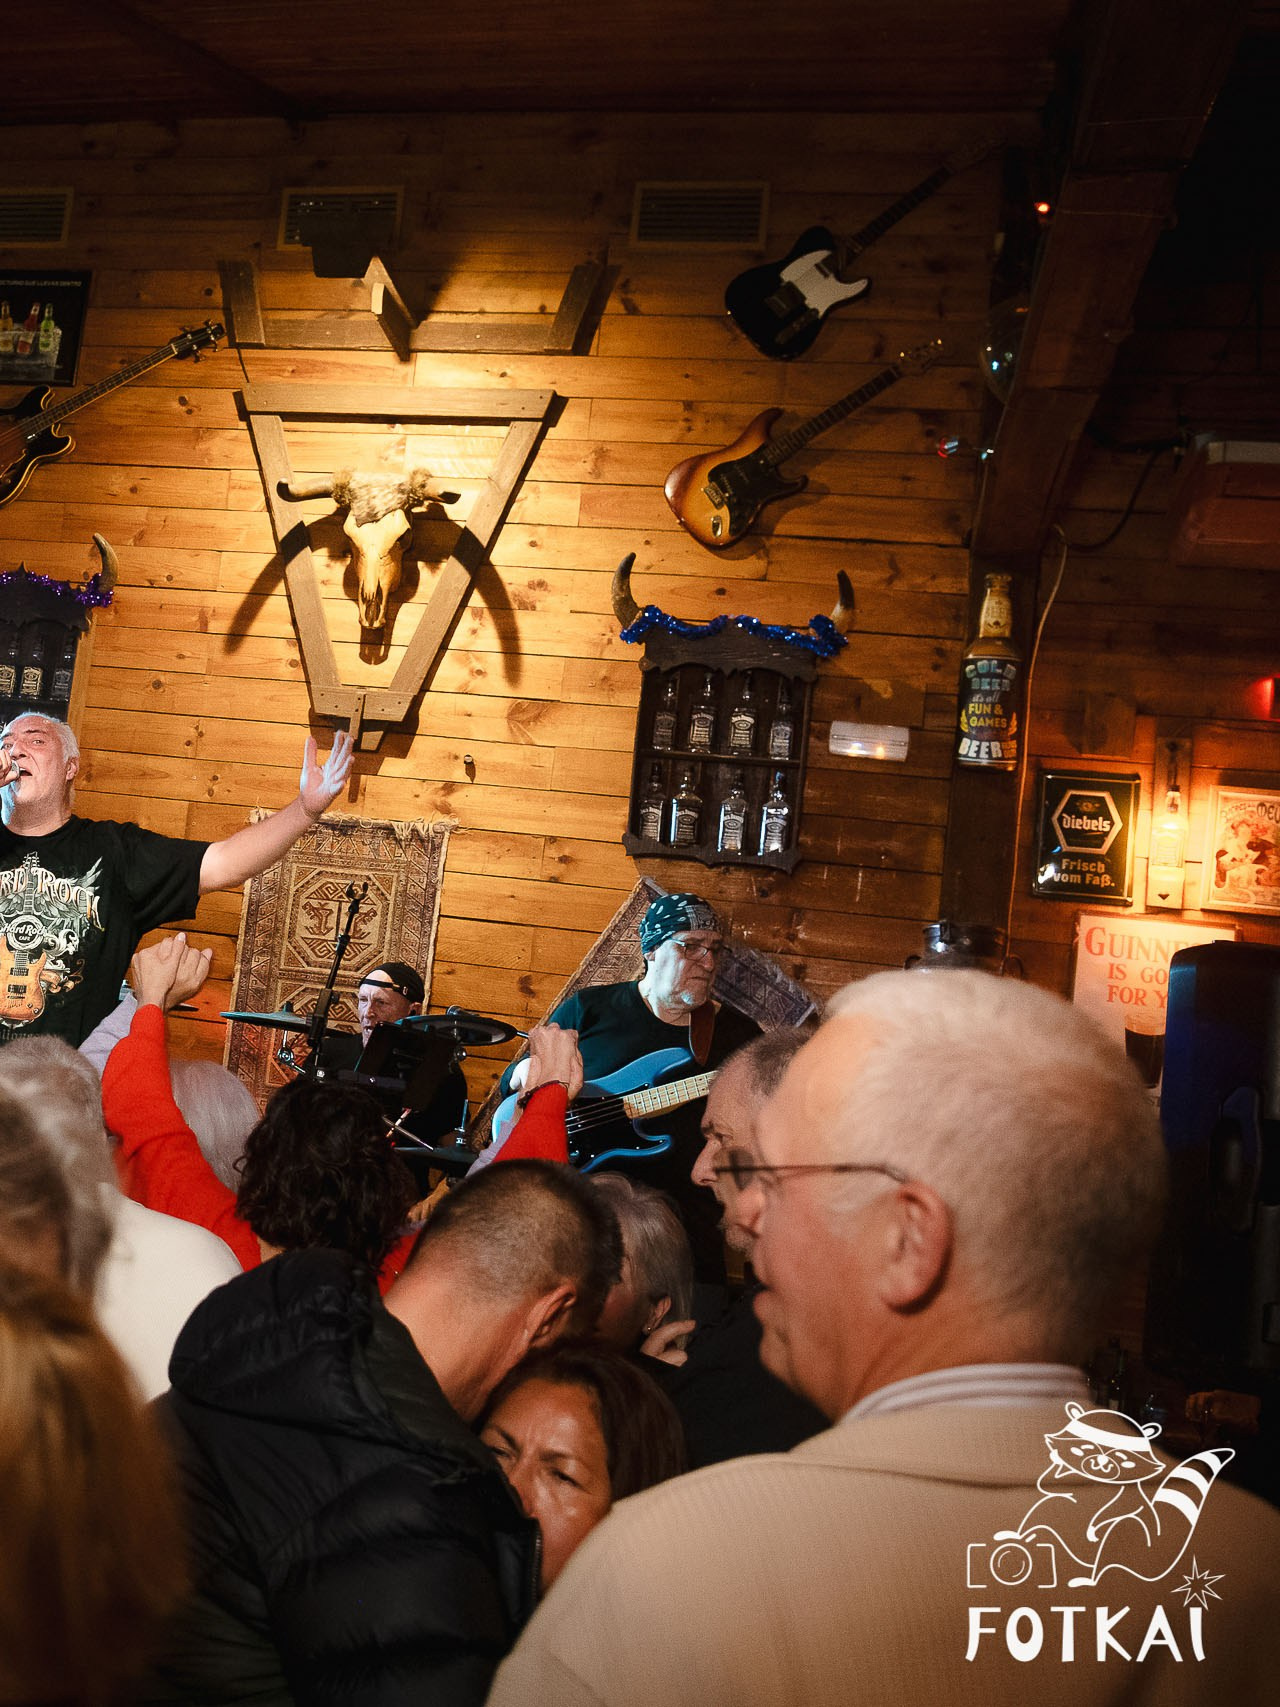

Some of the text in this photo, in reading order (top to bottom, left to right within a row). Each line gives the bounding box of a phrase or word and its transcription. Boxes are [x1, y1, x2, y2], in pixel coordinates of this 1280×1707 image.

[965, 659, 1017, 680] COLD
[971, 677, 1010, 692] BEER
[968, 703, 1003, 715] FUN &
[969, 717, 1007, 729] GAMES
[958, 737, 1002, 759] BEER
[1053, 872, 1081, 884] vom
[31, 866, 105, 932] ROCK
[2, 923, 48, 936] Hard Rock
[1085, 926, 1200, 963] GUINN
[1107, 963, 1169, 985] IS GO
[1107, 984, 1146, 1006] FOR
